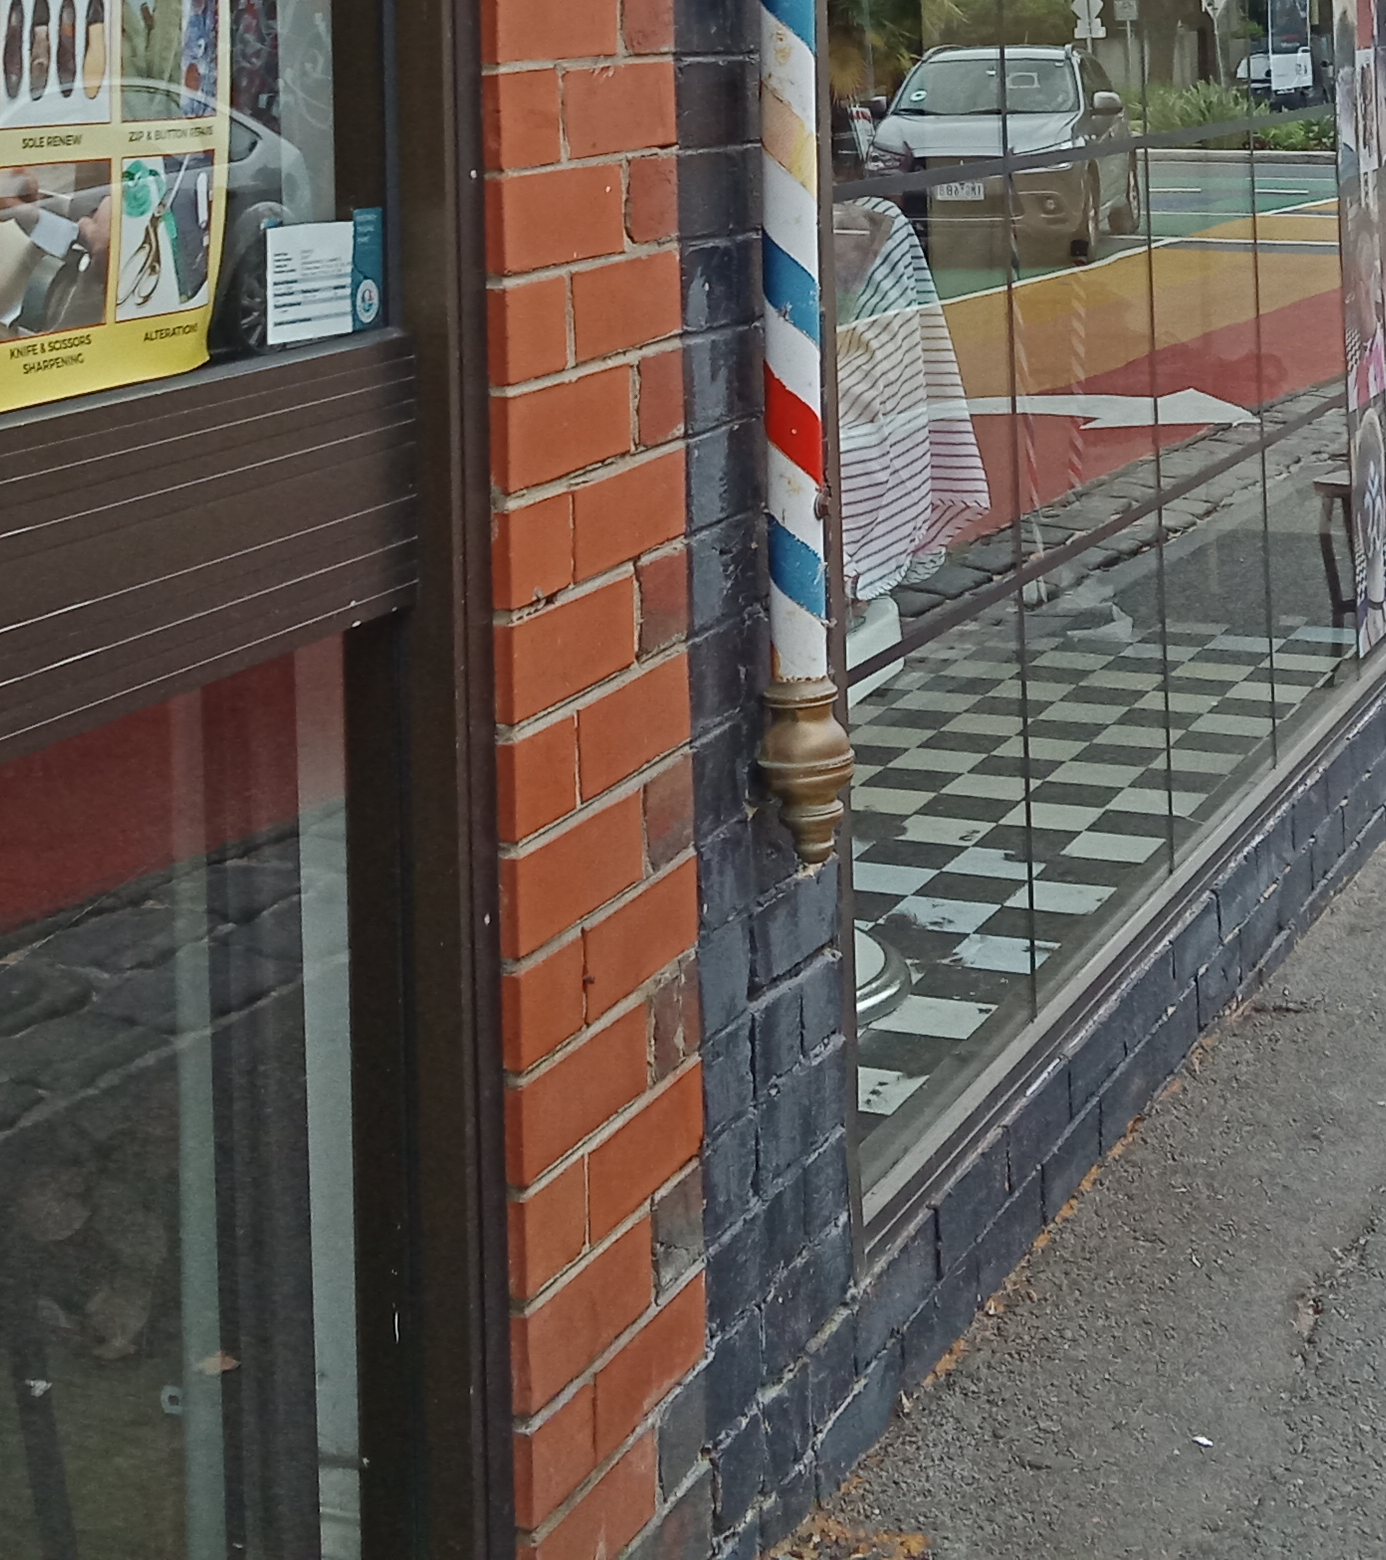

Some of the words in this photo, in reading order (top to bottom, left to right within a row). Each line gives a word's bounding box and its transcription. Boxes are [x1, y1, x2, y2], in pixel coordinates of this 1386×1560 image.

[22, 137, 45, 150] SOLE
[47, 134, 82, 148] RENEW
[154, 127, 187, 140] BUTTON
[9, 345, 38, 360] KNIFE
[40, 343, 46, 355] &
[47, 334, 92, 353] SCISSORS
[23, 353, 84, 375] SHARPENING
